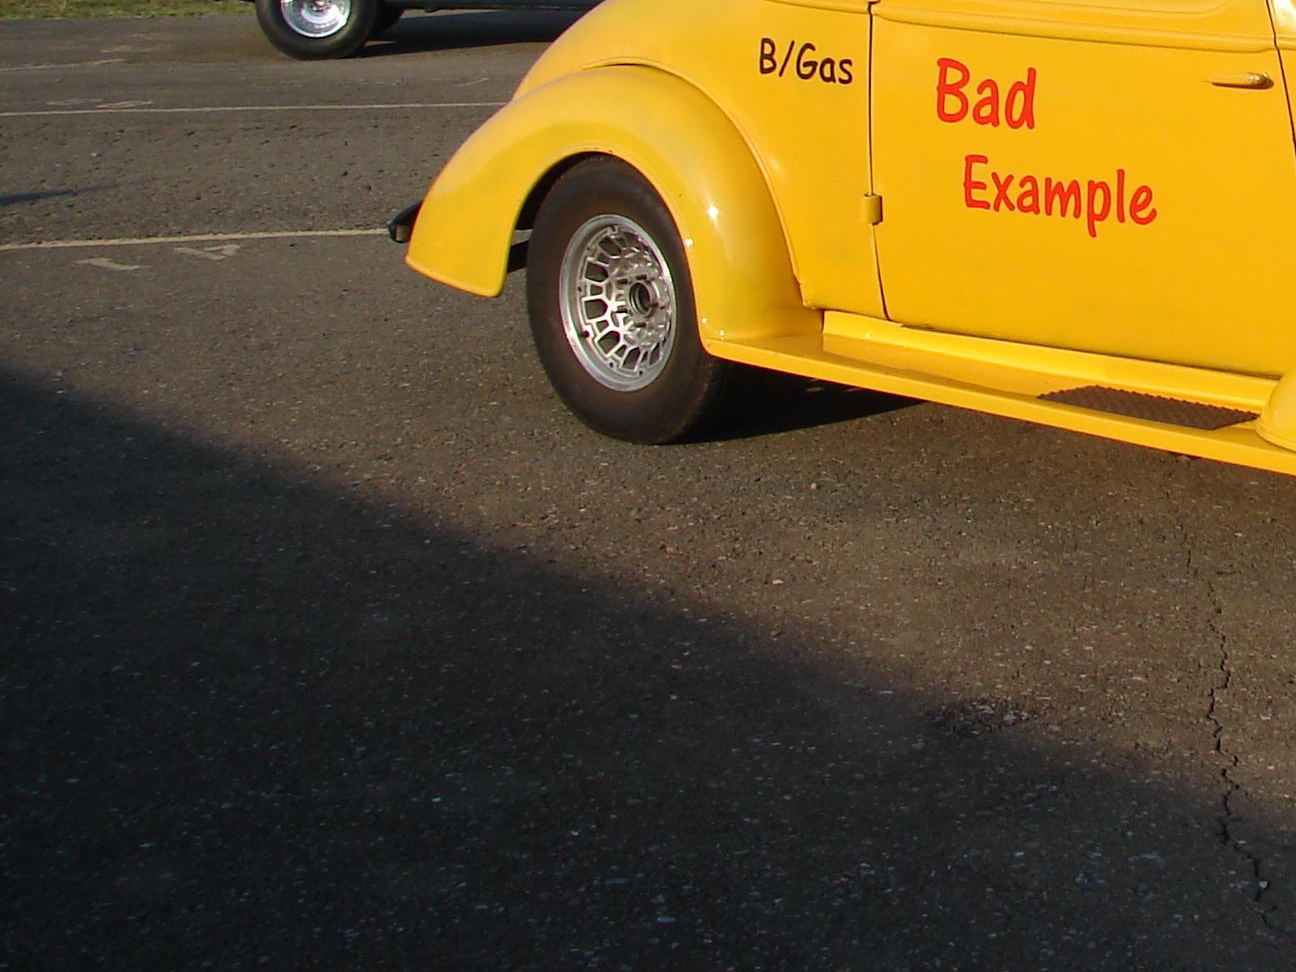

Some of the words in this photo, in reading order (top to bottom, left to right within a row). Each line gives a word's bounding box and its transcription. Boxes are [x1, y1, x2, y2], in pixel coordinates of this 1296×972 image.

[760, 37, 853, 85] B/Gas
[936, 57, 1037, 130] Bad
[963, 154, 1157, 239] Example
